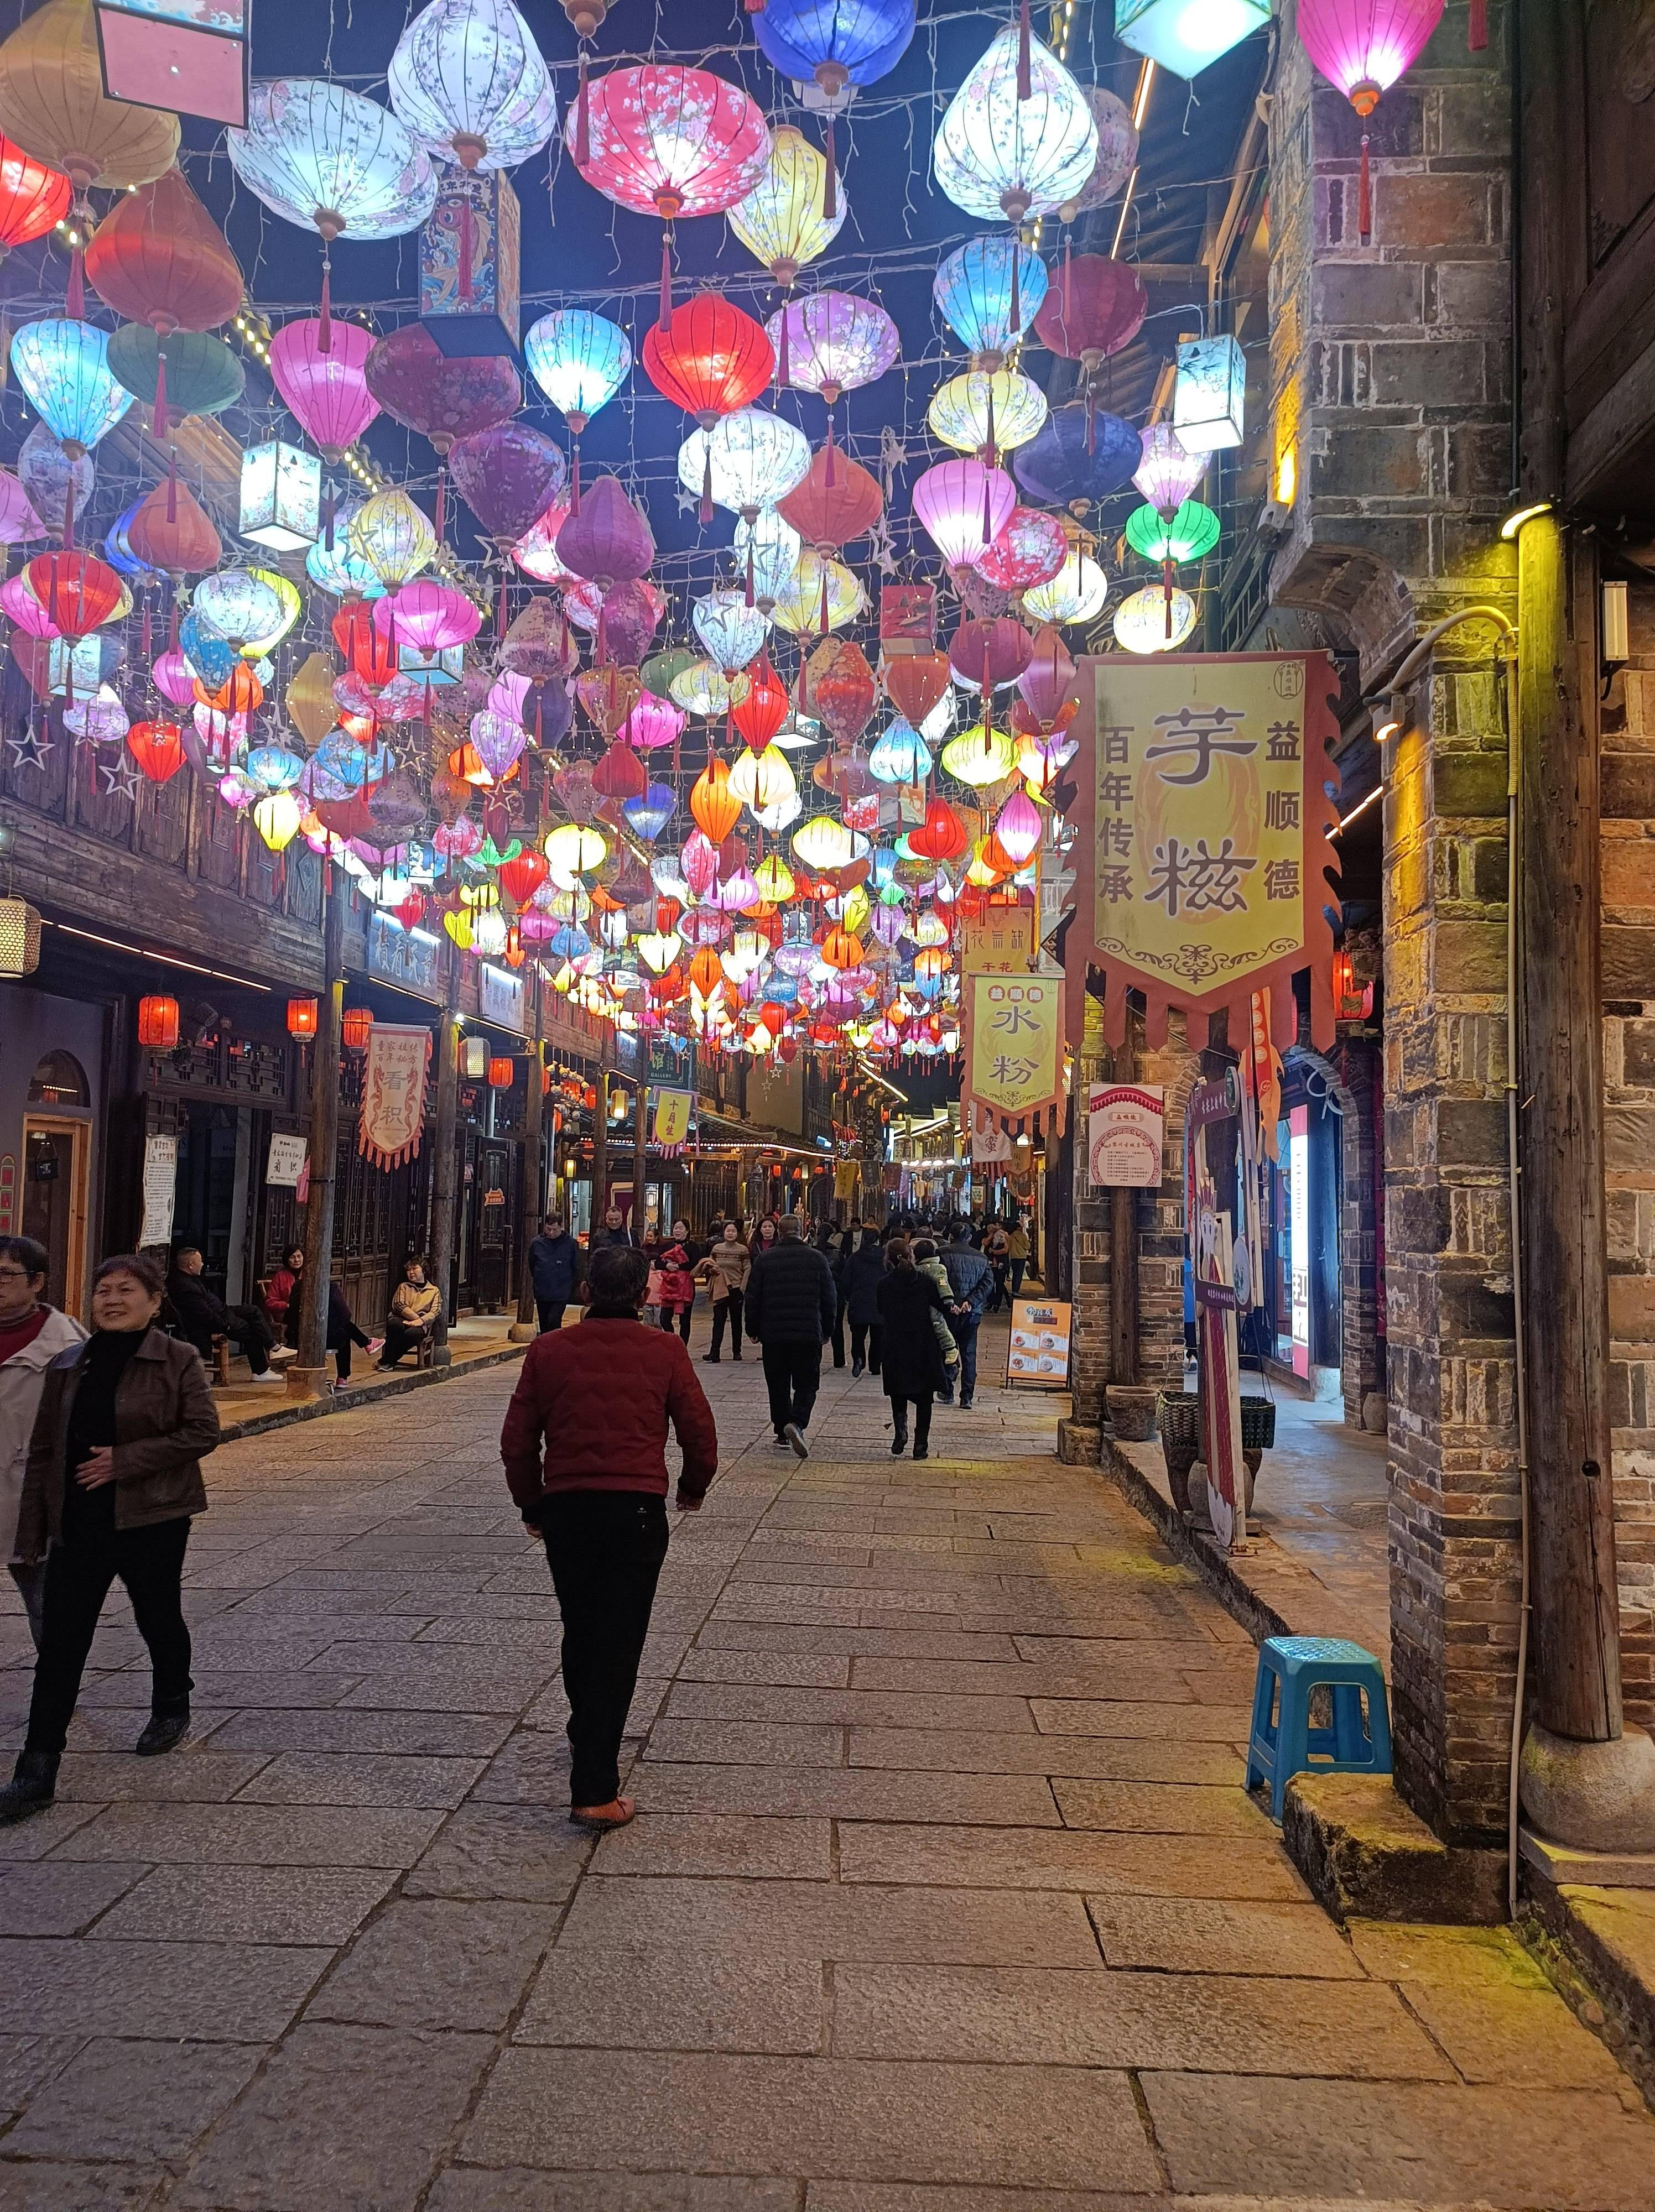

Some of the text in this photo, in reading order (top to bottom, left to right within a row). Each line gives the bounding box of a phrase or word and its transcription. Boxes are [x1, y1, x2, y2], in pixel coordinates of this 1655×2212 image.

[1098, 726, 1134, 904] 百年传承
[1144, 707, 1258, 917] 芋糍
[1263, 720, 1302, 901] 益顺德
[990, 987, 1042, 1001] 益顺德
[376, 1052, 418, 1065] 百年秘方
[988, 1005, 1041, 1085] 水粉
[380, 1070, 408, 1125] 看积
